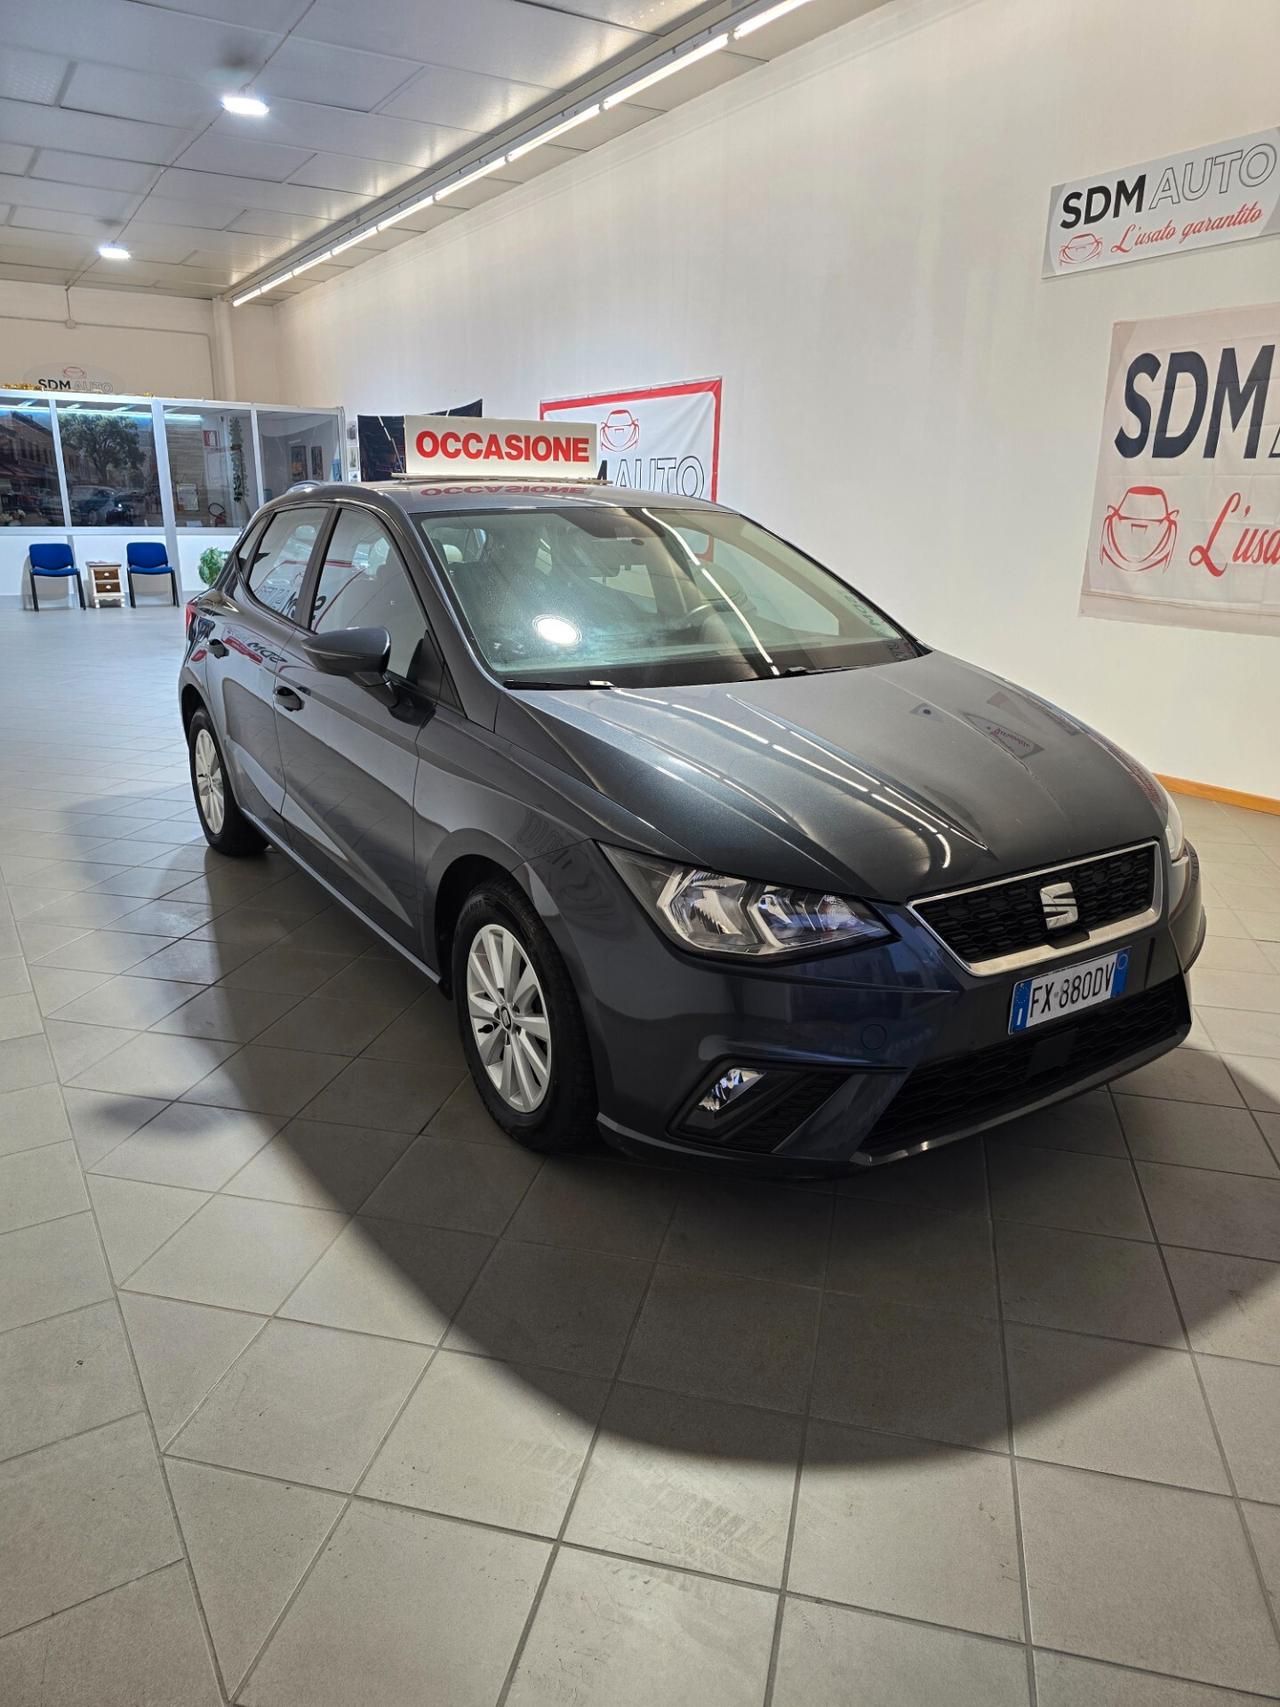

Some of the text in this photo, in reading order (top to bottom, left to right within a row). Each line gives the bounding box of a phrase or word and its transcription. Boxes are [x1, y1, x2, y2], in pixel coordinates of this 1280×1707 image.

[1060, 143, 1277, 229] SDM AUTO
[1110, 200, 1263, 253] L'usato garantito
[38, 378, 71, 391] SDM
[1114, 344, 1276, 459] SDM
[415, 431, 589, 462] OCCASIONE
